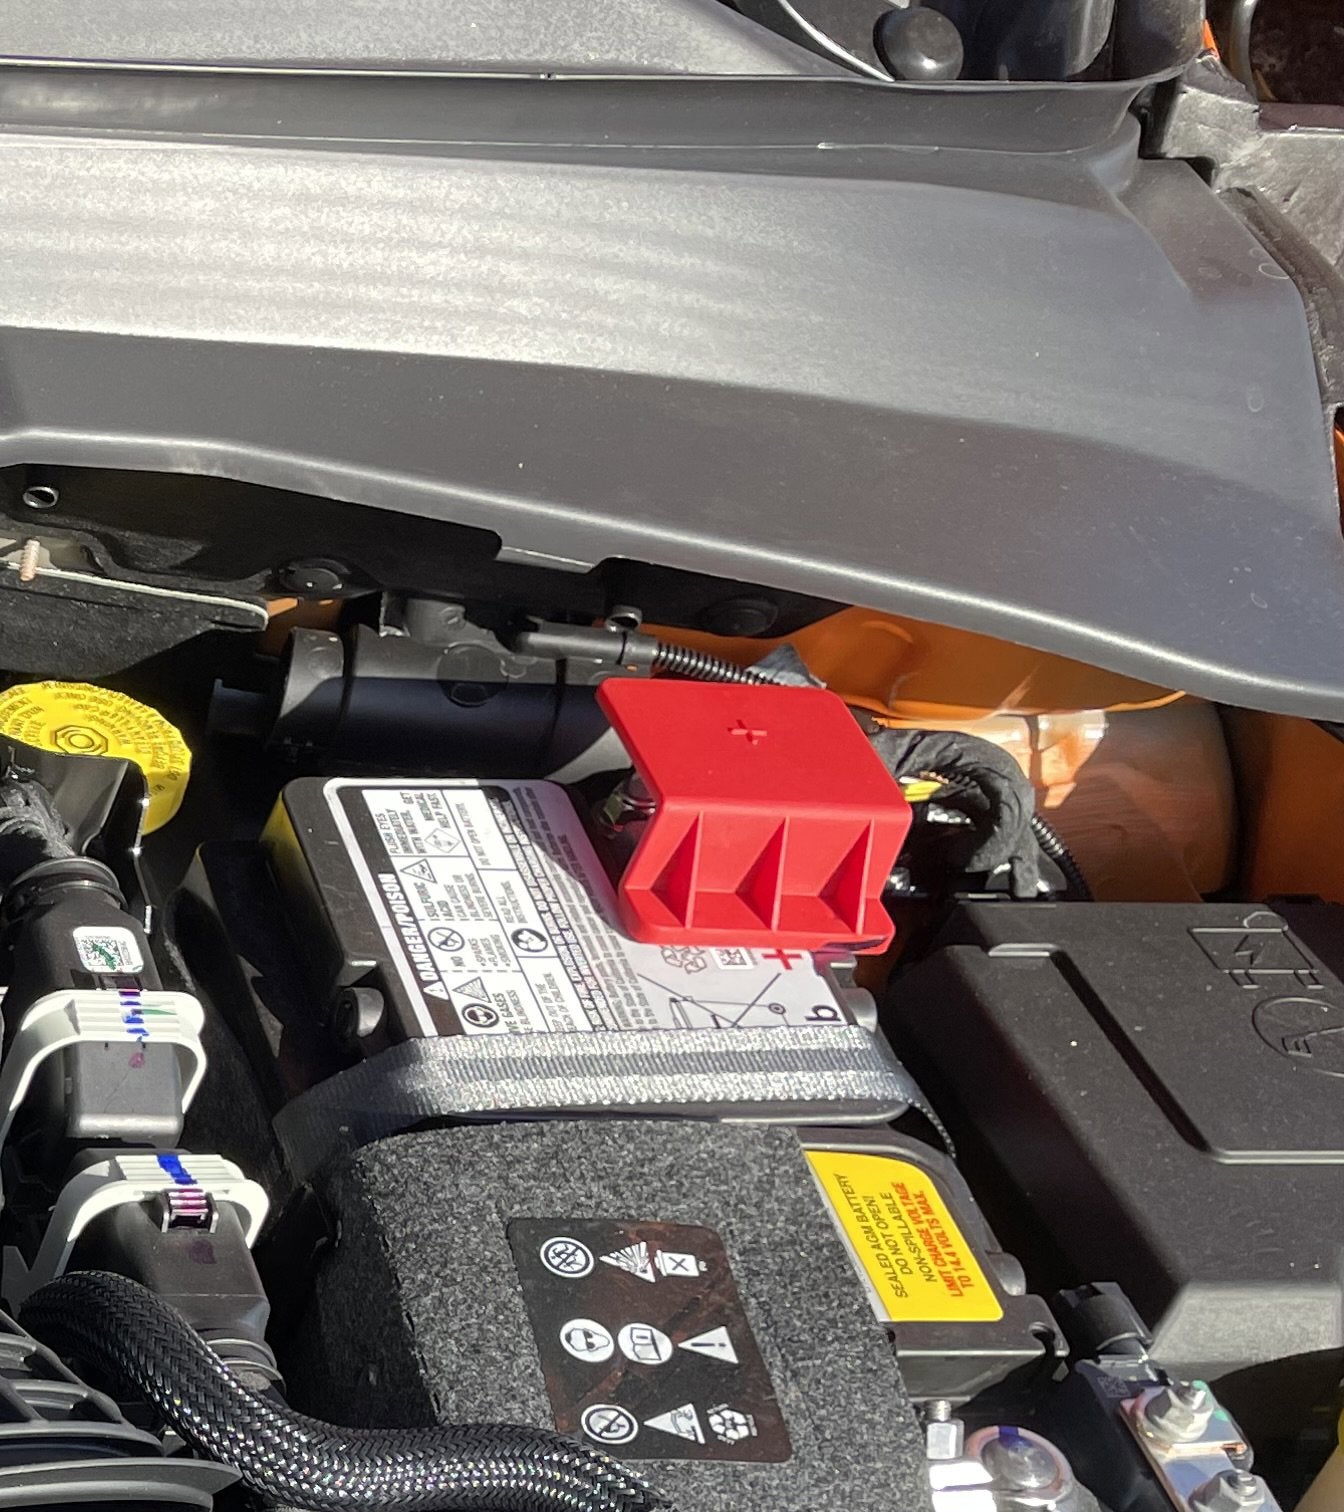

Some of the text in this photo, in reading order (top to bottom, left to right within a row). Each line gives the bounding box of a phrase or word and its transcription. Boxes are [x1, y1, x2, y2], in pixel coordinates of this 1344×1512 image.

[375, 813, 392, 830] EYES
[378, 873, 440, 981] DANGER/POISON
[452, 956, 466, 967] NO
[834, 1174, 869, 1222] BATTERY
[861, 1226, 883, 1250] AGM
[880, 1192, 937, 1282] NON-SPILLABLE
[881, 1233, 903, 1255] NOT
[892, 1183, 964, 1297] LIMIT CHARGE VOLTAGE
[926, 1219, 953, 1248] VOLTS
[897, 1259, 913, 1275] DO
[941, 1252, 966, 1272] 14.4
[876, 1254, 908, 1298] SEALED
[958, 1276, 974, 1288] TO
